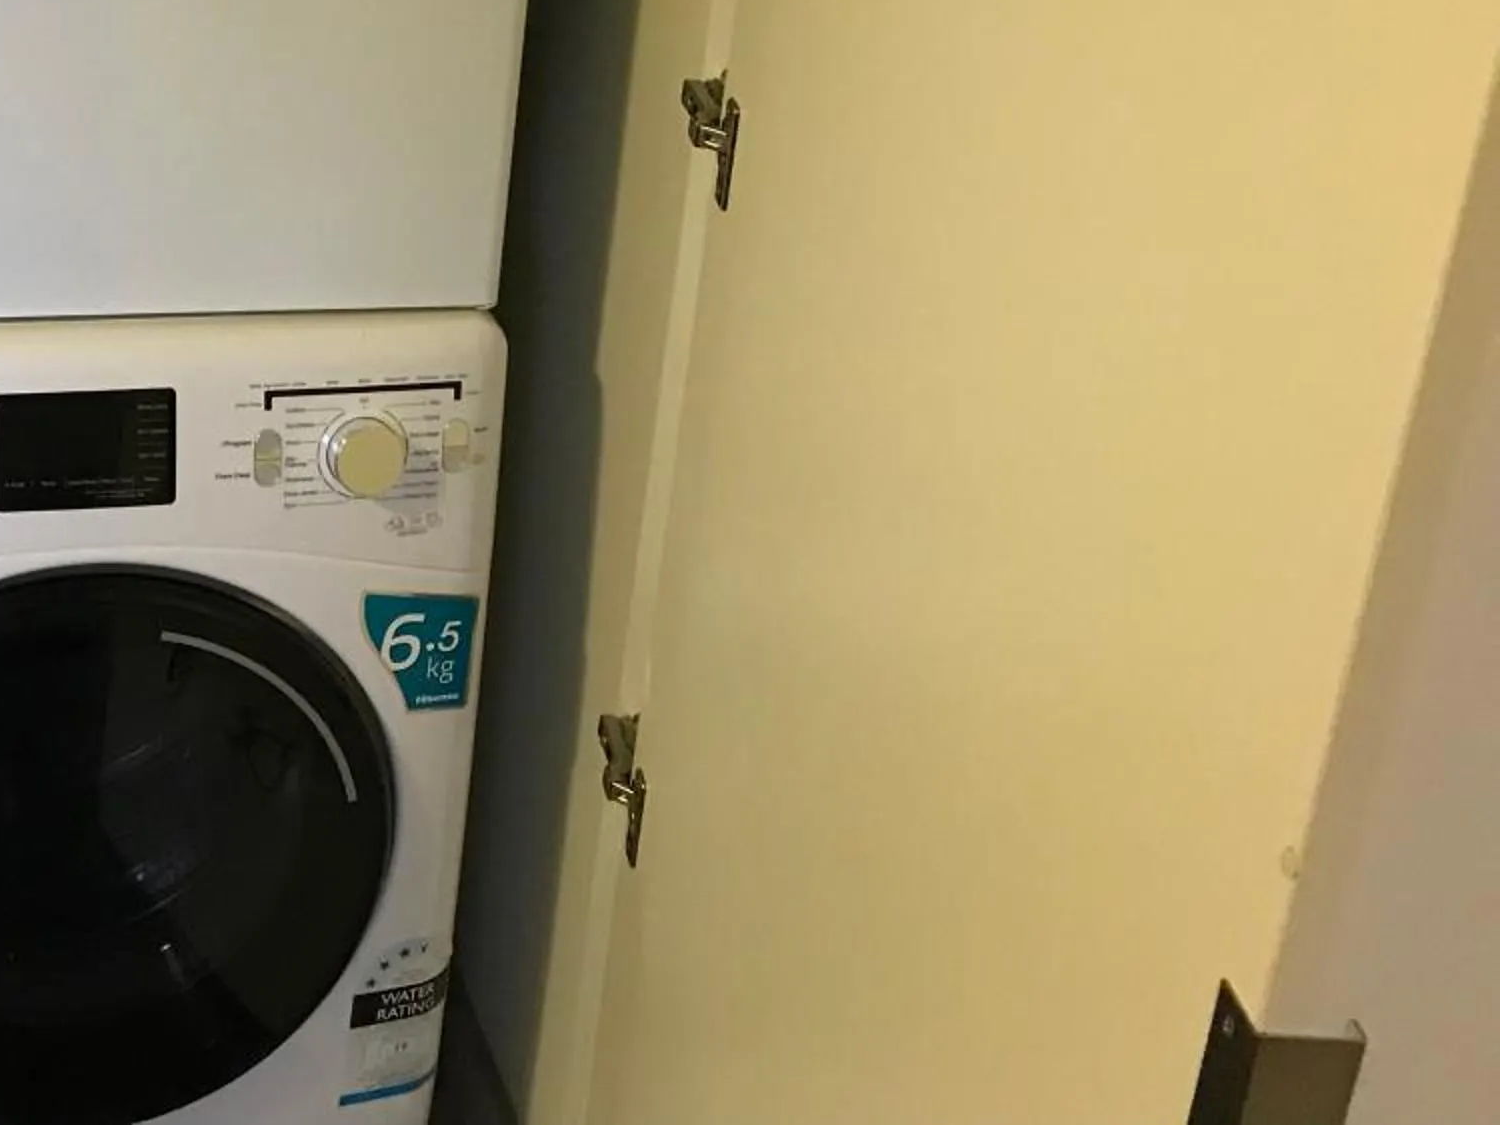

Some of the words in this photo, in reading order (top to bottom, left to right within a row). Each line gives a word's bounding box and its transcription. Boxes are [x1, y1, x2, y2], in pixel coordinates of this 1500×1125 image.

[381, 613, 462, 671] 6.5
[427, 657, 453, 684] kg
[381, 983, 434, 1006] WATER
[376, 997, 436, 1020] RATING
